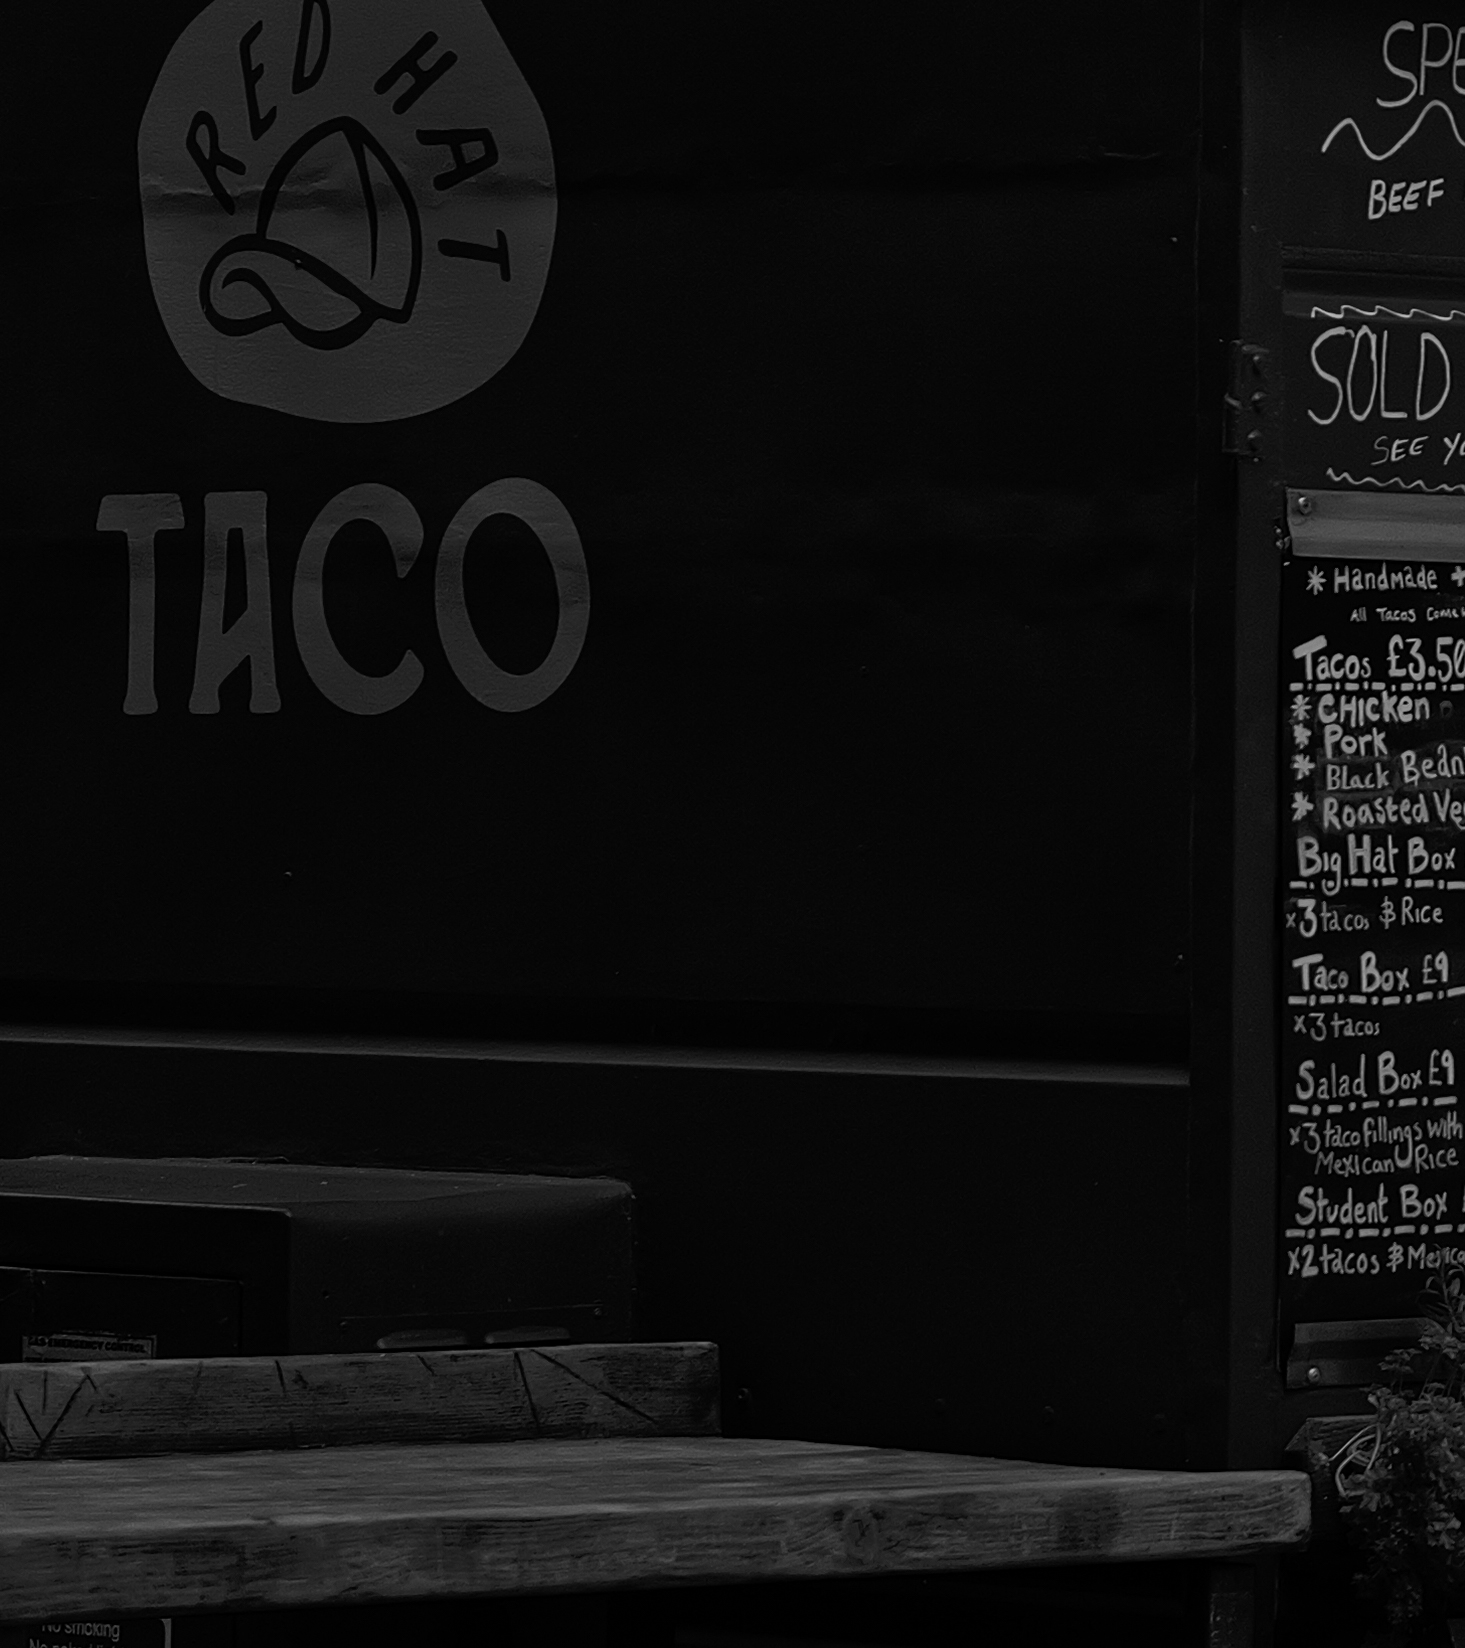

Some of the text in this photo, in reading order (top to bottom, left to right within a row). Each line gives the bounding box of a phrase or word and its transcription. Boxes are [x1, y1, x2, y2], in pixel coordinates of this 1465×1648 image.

[374, 30, 511, 282] HAT
[1368, 177, 1445, 221] BEEF
[1307, 324, 1451, 426] SOLD
[1370, 434, 1429, 466] SEE
[95, 476, 591, 716] TACO
[1333, 563, 1438, 593] Handmade
[1350, 606, 1366, 622] All
[1376, 607, 1416, 623] Tacos
[1426, 607, 1459, 621] Come
[1292, 634, 1372, 680] Tacos
[1322, 725, 1389, 758] Pork
[1325, 762, 1391, 791] Black
[1322, 795, 1429, 831] Roasted
[1296, 836, 1341, 896] Big
[1347, 833, 1399, 875] Hat
[1406, 836, 1456, 875] Box
[1322, 901, 1370, 933] tacos
[1401, 896, 1444, 927] Rice
[1292, 951, 1450, 992] Taco Box £9
[1331, 1012, 1380, 1038] tacos
[1295, 1049, 1455, 1101] Salad Box £9
[1323, 1119, 1360, 1148] taco
[1362, 1116, 1423, 1169] fillings
[1427, 1111, 1463, 1140] with
[1415, 1144, 1460, 1174] Rice
[1294, 1182, 1389, 1225] Student
[1400, 1182, 1448, 1220] Box
[1321, 1244, 1380, 1275] tacos
[104, 1342, 146, 1354] CONTROL
[64, 1622, 121, 1642] smoking
